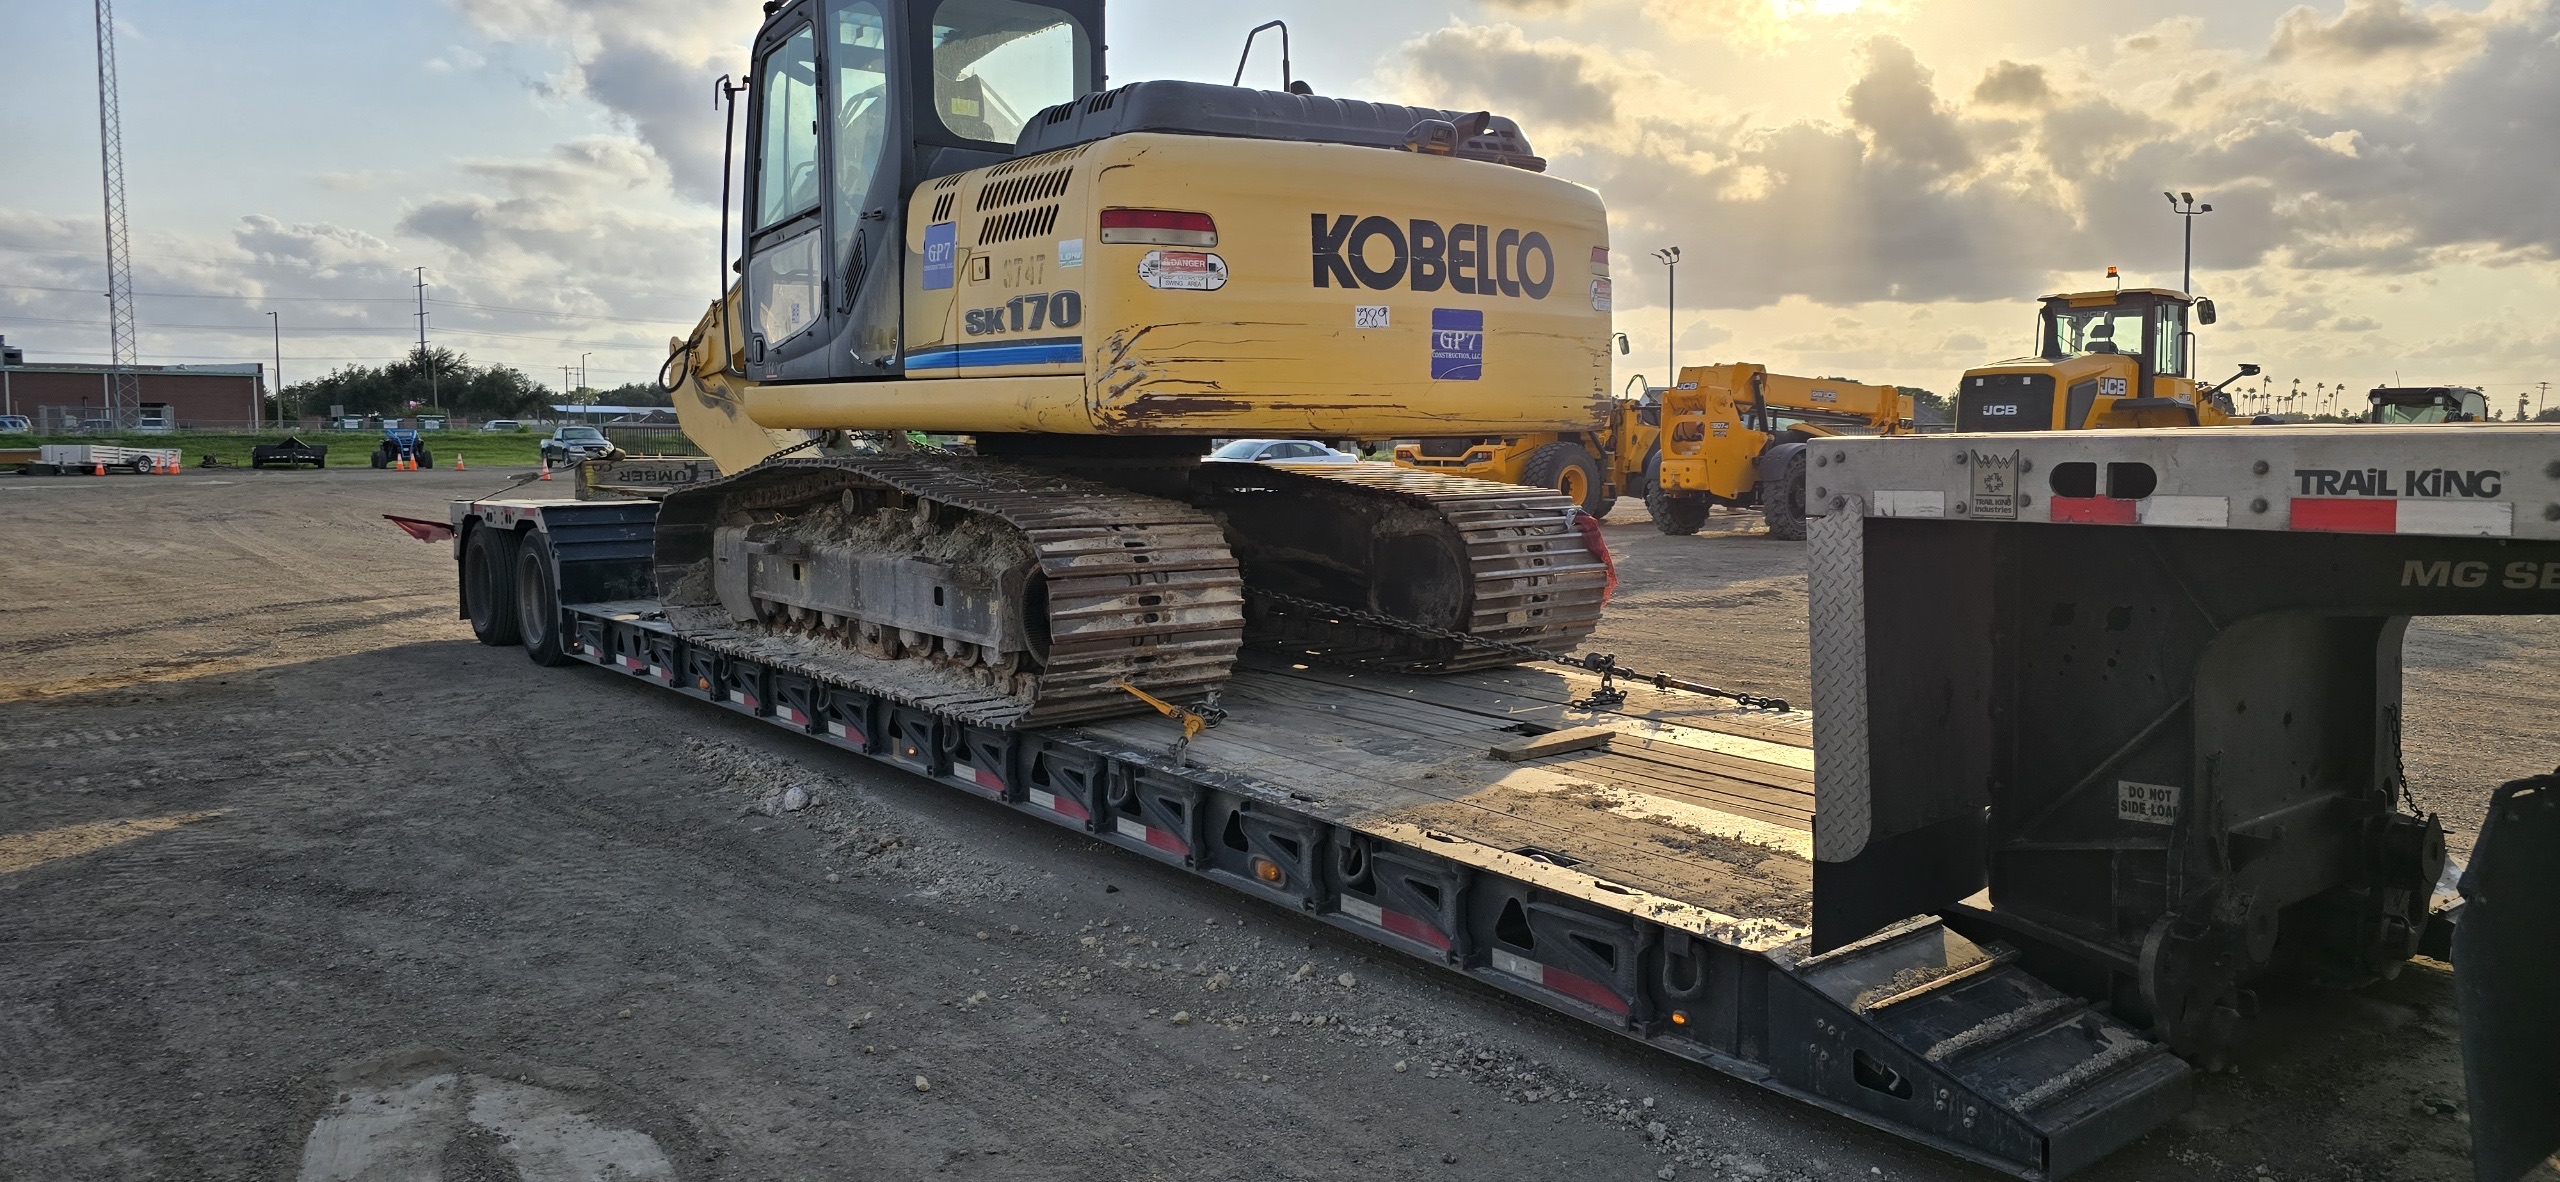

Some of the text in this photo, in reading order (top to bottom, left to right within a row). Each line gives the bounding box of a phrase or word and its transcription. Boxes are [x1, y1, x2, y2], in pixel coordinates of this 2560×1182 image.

[929, 242, 951, 262] GP7
[1311, 213, 1555, 300] KOBELCO
[1171, 258, 1206, 268] DANGER
[965, 290, 1082, 336] SK170
[1358, 307, 1388, 328] 289
[1440, 330, 1476, 351] GP7
[1677, 382, 1698, 390] JCB
[2101, 378, 2127, 395] JCB
[1983, 405, 2018, 416] JCB
[2400, 560, 2489, 588] MG
[2128, 785, 2172, 803] DO NOT
[2120, 799, 2147, 815] SIDE
